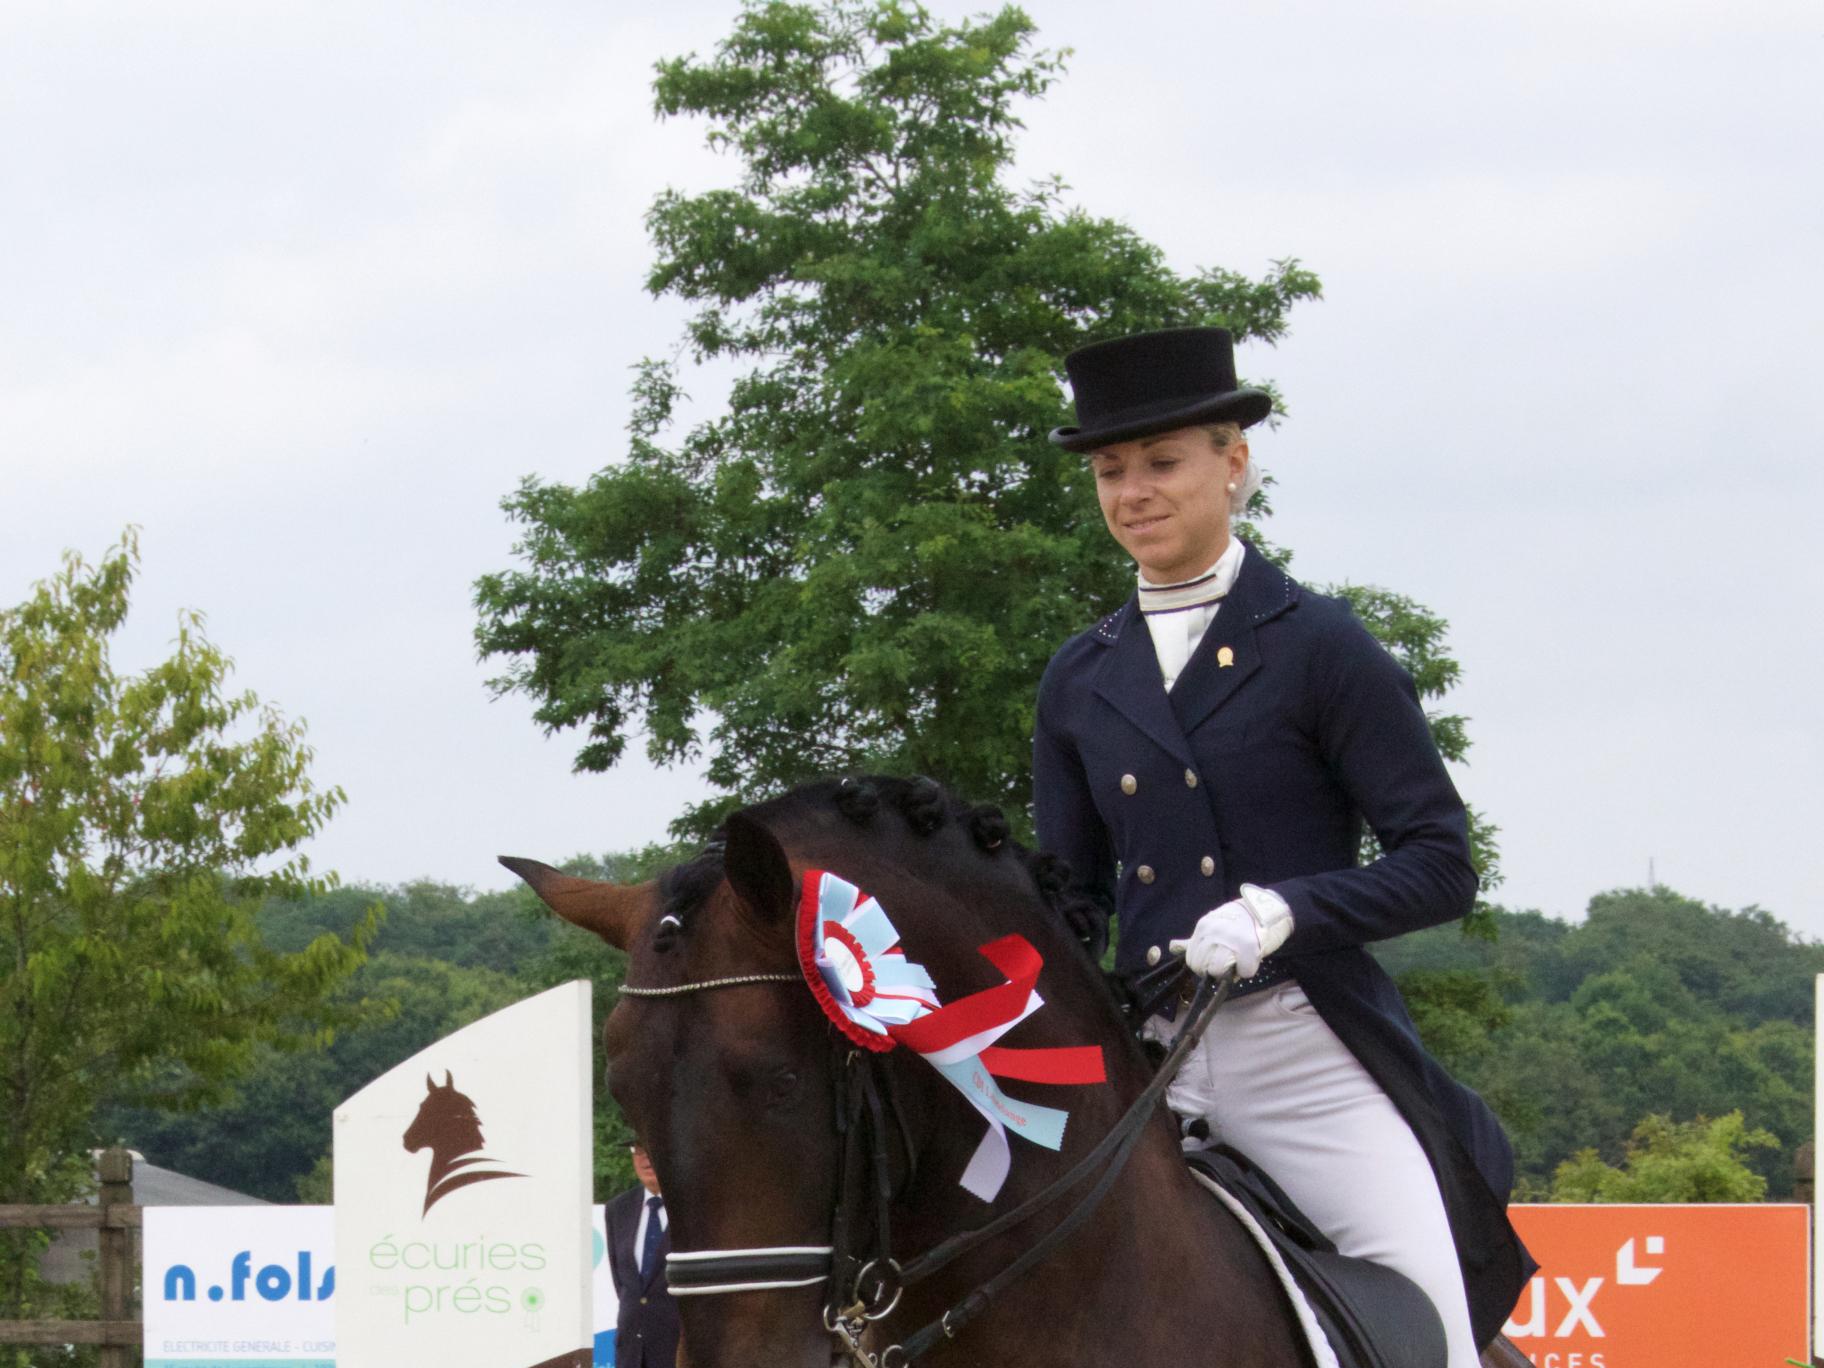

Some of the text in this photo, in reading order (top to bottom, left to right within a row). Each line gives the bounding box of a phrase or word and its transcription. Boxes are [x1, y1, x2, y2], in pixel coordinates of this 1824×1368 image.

[369, 1233, 547, 1271] écuries
[369, 1277, 512, 1325] des prés
[163, 1340, 230, 1353] ELECTRICITE
[233, 1340, 291, 1353] GENERALE
